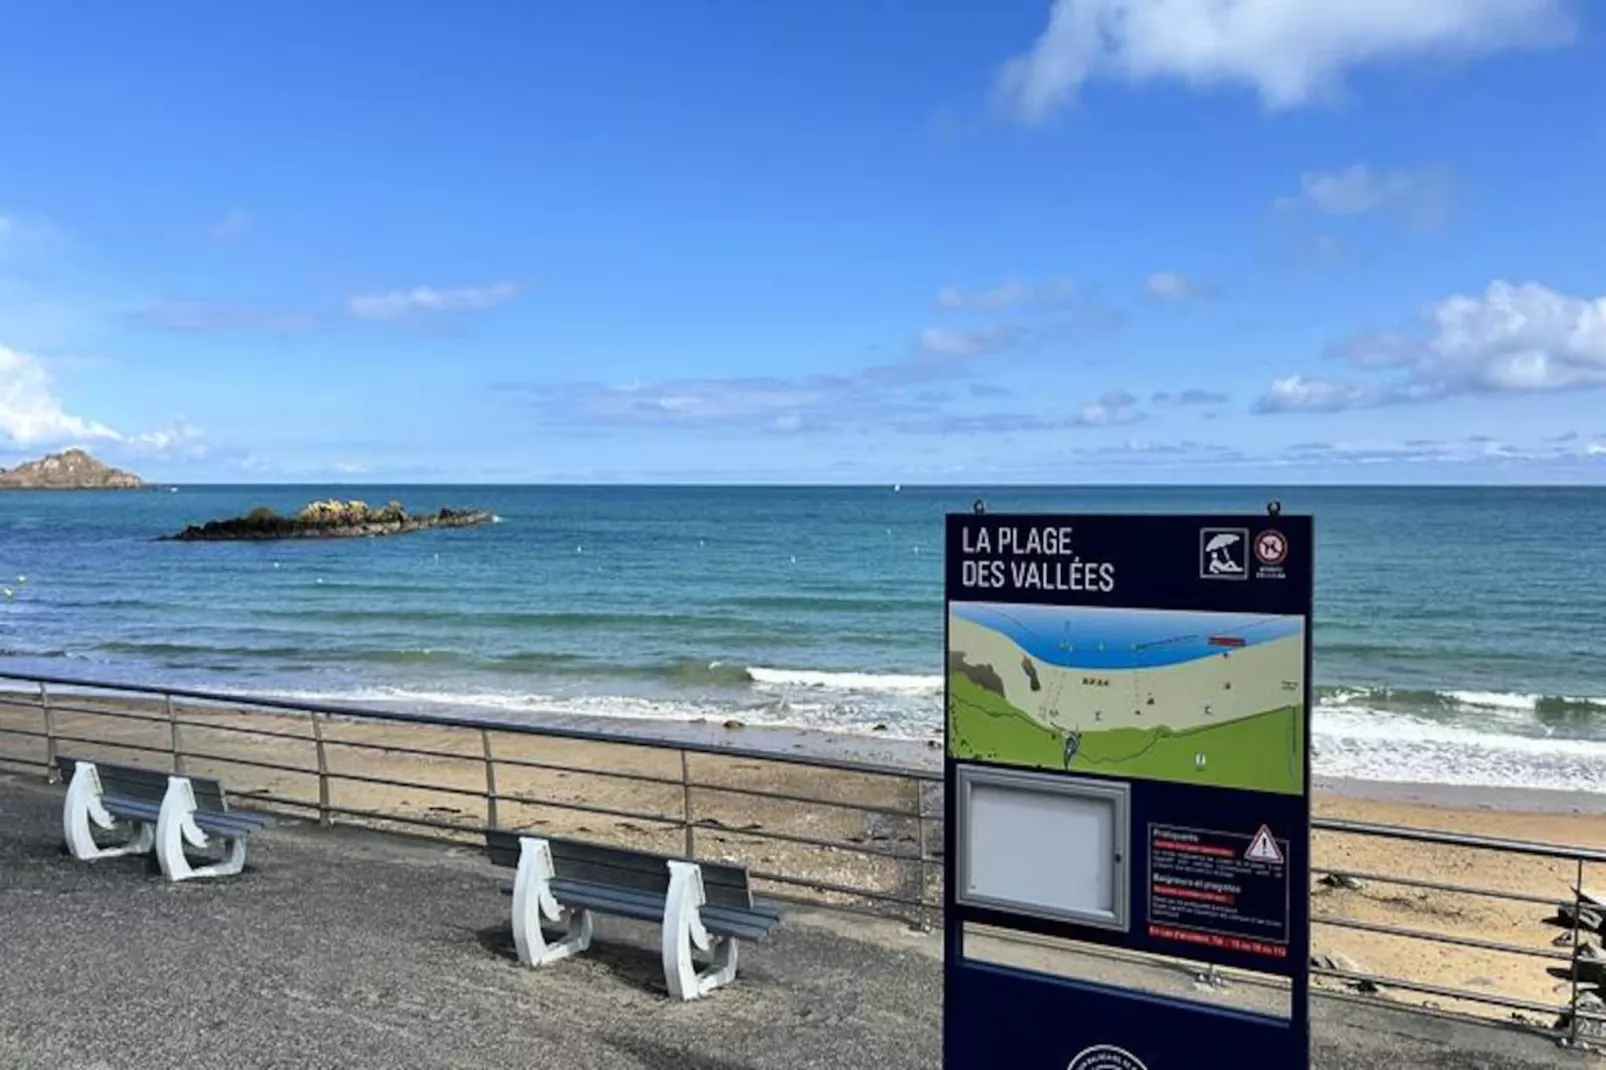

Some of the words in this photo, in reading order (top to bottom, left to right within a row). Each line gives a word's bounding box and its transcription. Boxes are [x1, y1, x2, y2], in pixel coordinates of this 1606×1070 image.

[963, 527, 991, 554] LA
[998, 527, 1073, 555] PLAGE
[962, 560, 1005, 588] DES
[1011, 556, 1115, 592] VALLÉES
